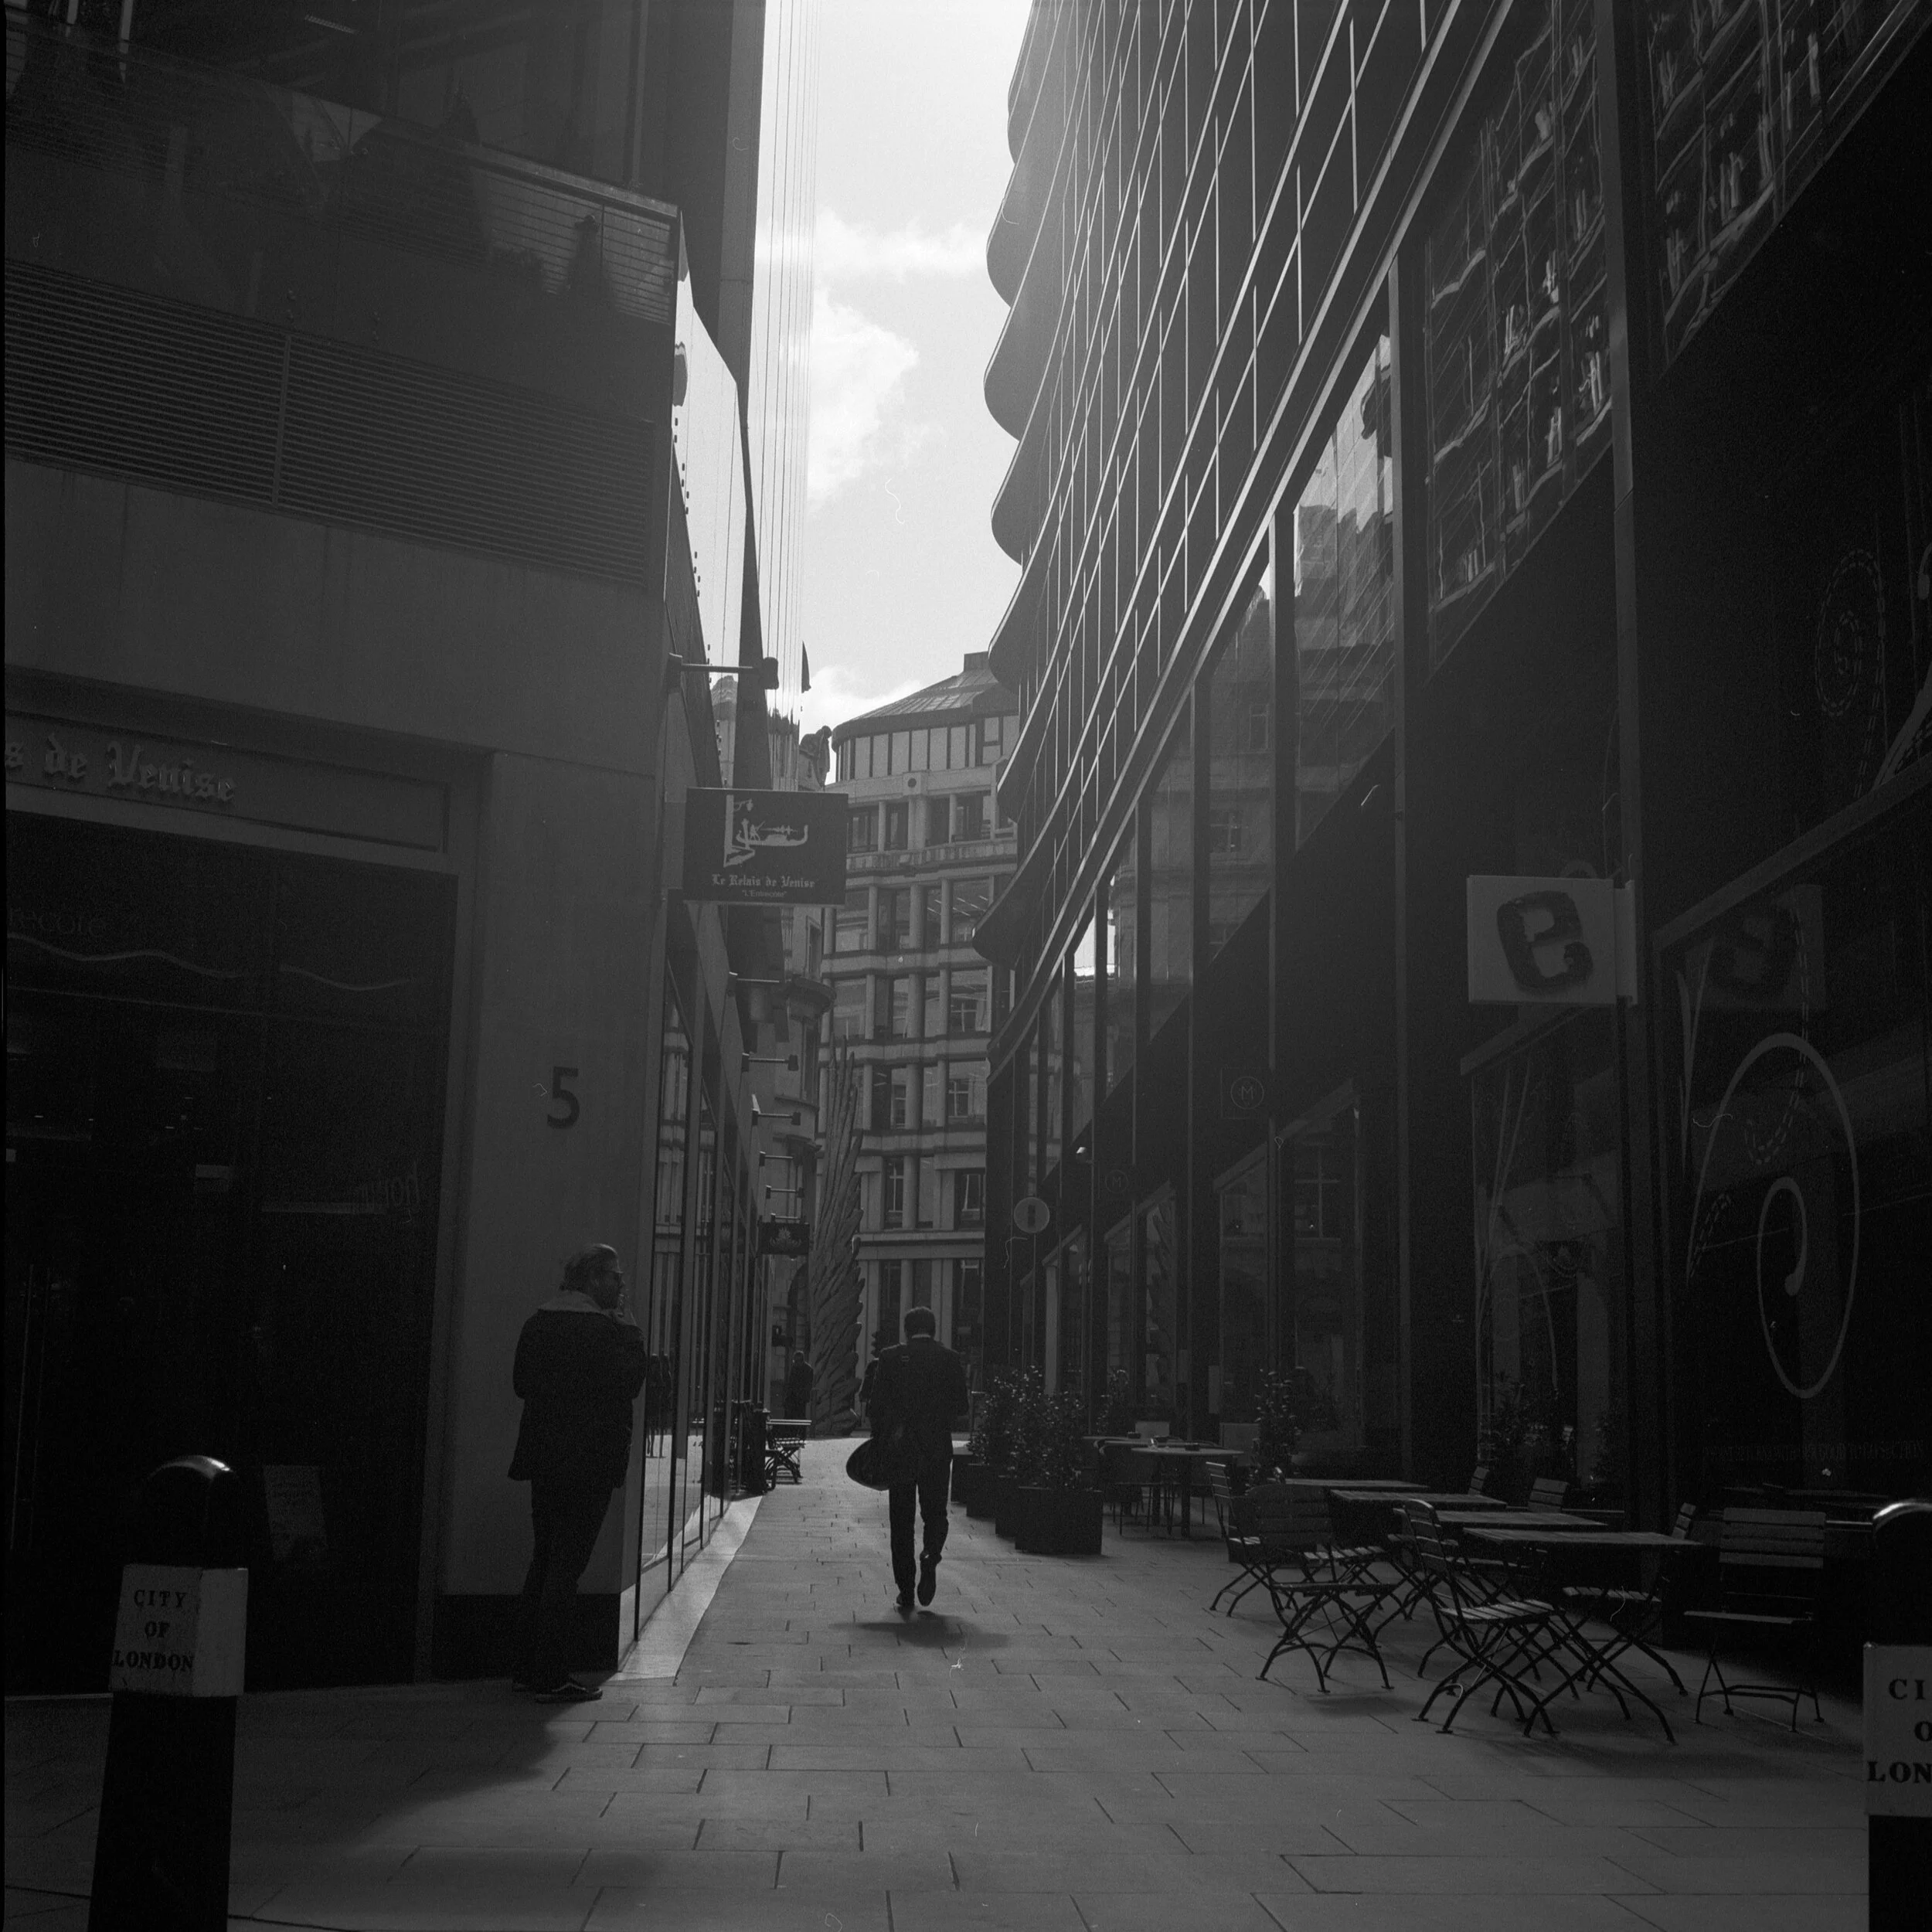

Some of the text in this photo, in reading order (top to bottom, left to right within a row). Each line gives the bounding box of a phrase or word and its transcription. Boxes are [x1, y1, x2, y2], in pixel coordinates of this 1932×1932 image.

[45, 733, 87, 777] de
[108, 741, 237, 800] Venise
[712, 874, 815, 888] Le Relais de Venise
[547, 1066, 580, 1129] 5
[1241, 1086, 1254, 1100] M
[134, 1590, 187, 1607] CITY
[145, 1621, 170, 1638] OF
[111, 1650, 195, 1672] LONDON
